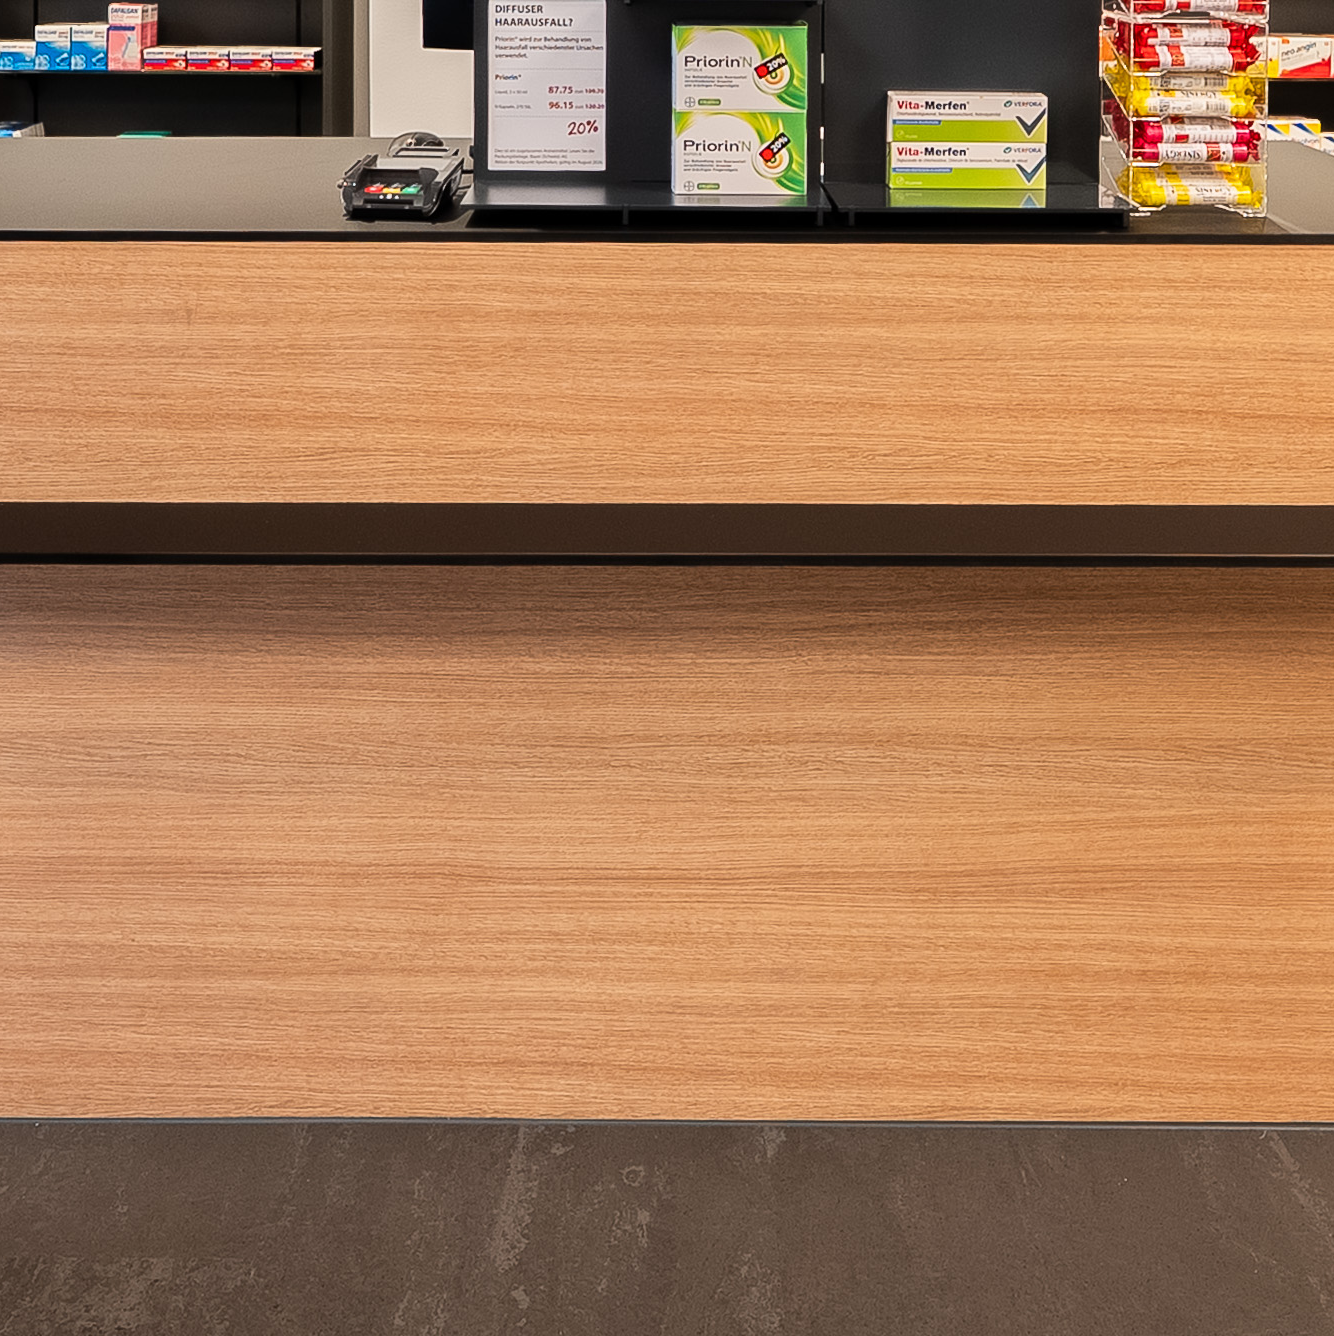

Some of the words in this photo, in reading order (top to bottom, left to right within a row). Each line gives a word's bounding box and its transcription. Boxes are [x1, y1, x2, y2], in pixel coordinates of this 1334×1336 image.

[494, 4, 543, 13] DIFFUSER
[494, 18, 573, 27] HAARAUSFALL?
[684, 55, 740, 68] Priorin
[767, 56, 786, 71] 20%
[548, 86, 574, 95] 87.75
[548, 101, 574, 109] 96.15
[567, 120, 599, 136] 20%
[683, 139, 740, 152] Priorin
[771, 136, 788, 152] 20%
